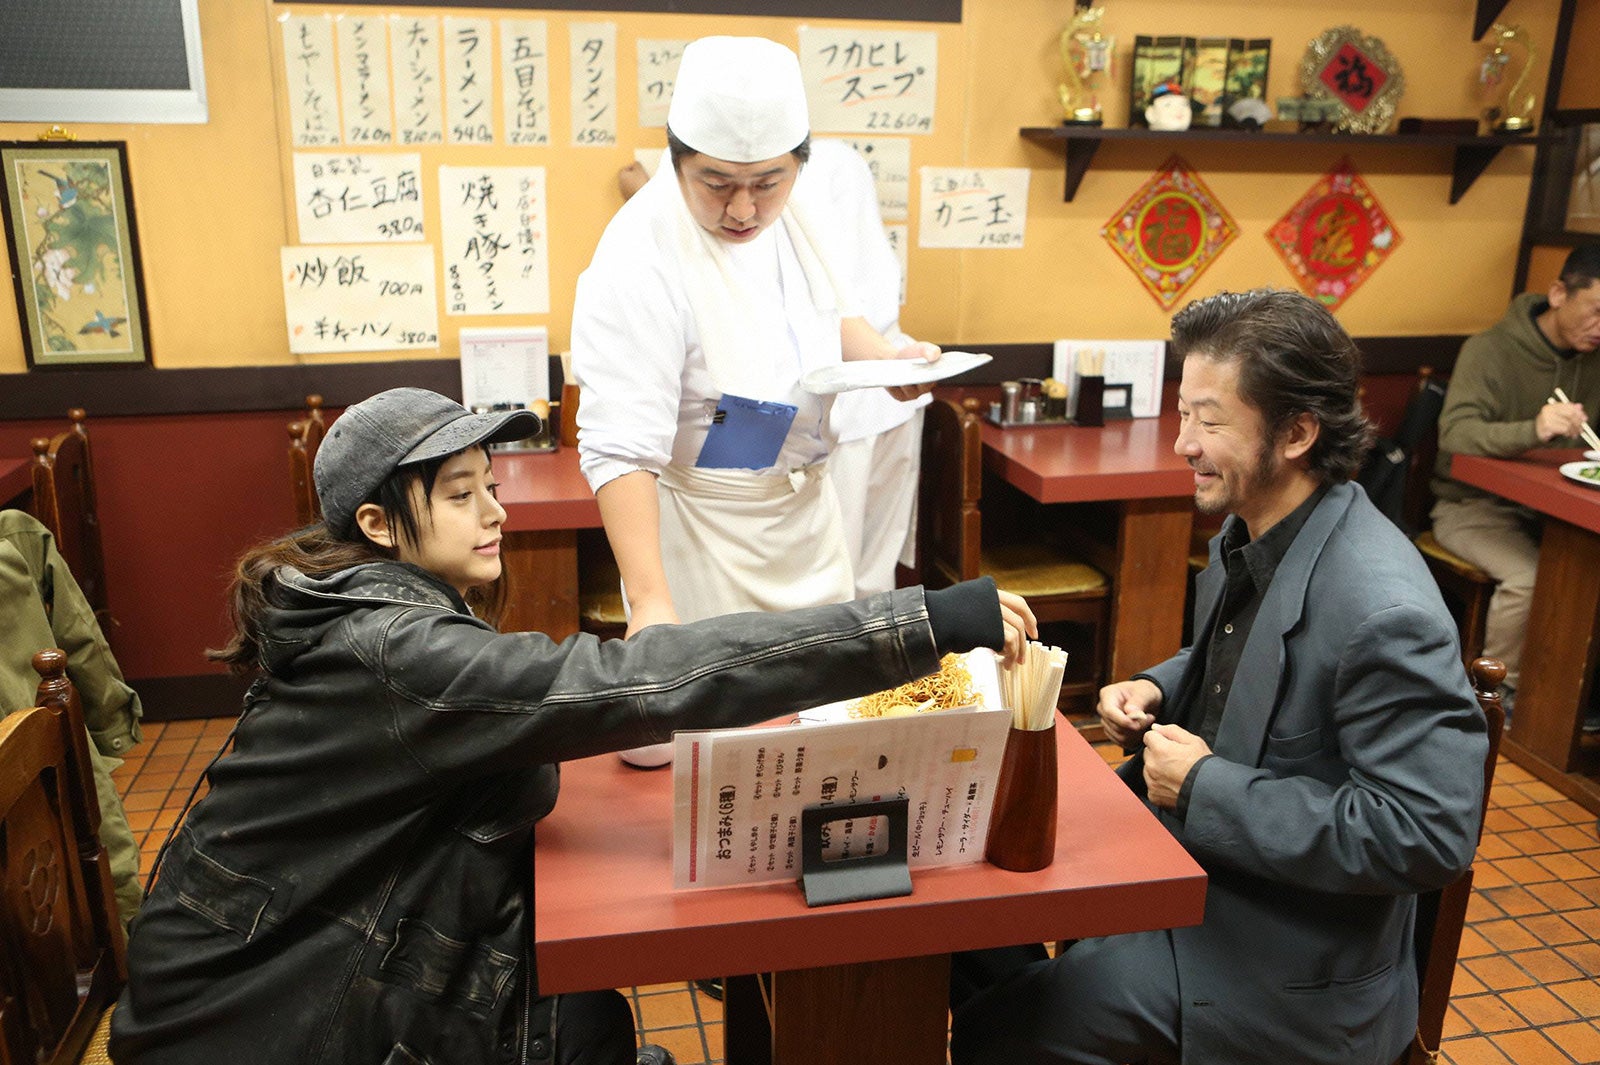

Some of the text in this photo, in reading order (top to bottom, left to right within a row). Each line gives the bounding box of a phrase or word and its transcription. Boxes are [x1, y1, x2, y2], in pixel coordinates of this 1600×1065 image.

[457, 28, 485, 119] ラーメン
[819, 40, 906, 67] フカヒレ
[511, 37, 545, 129] 五目そば
[582, 38, 608, 122] タンメン
[841, 66, 925, 102] スープ
[308, 170, 419, 219] 杏仁豆腐
[936, 194, 1012, 228] カニ玉
[1145, 202, 1192, 261] 福
[296, 255, 369, 288] 炒飯
[314, 316, 393, 343] 半チャーハン
[716, 785, 736, 860] おつまみ(6種)
